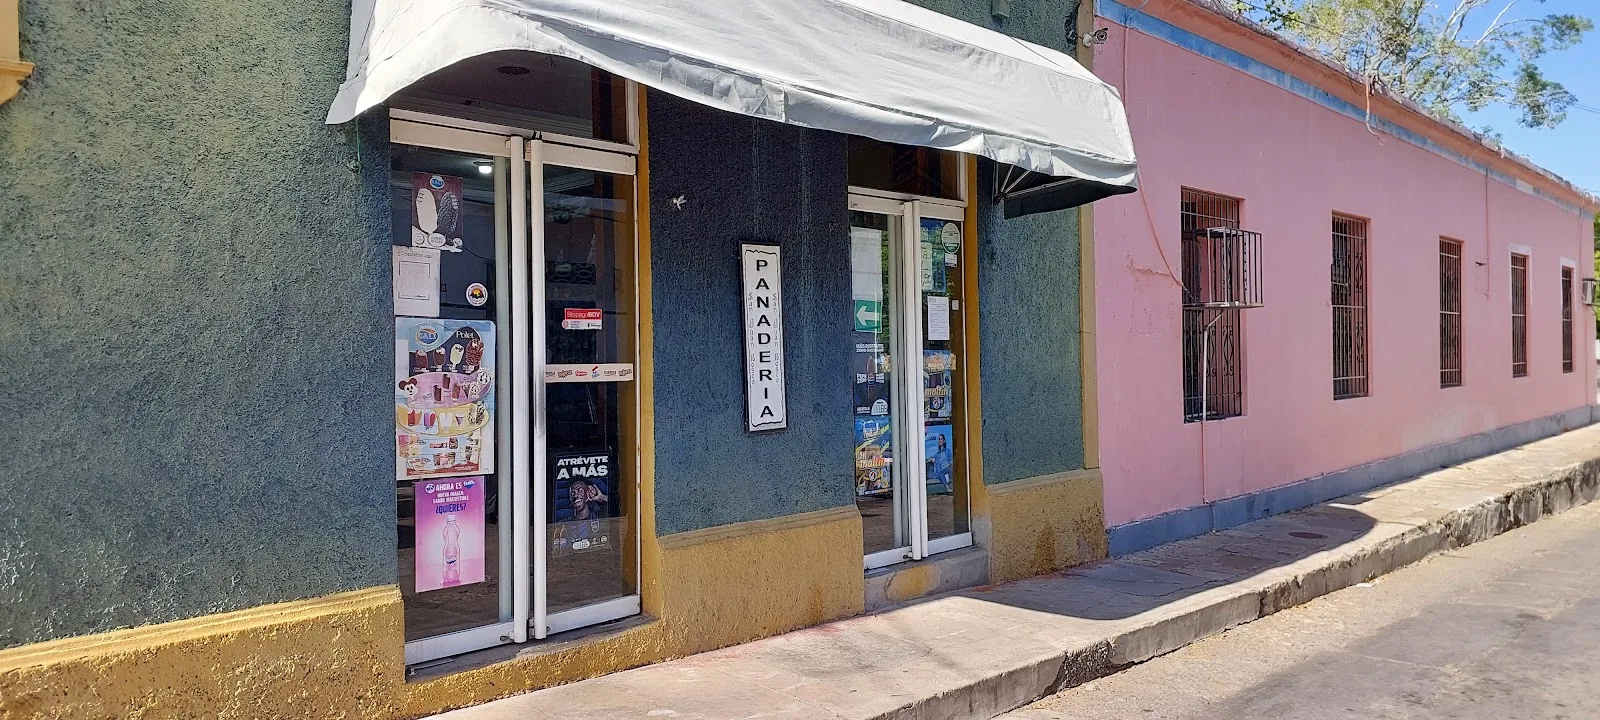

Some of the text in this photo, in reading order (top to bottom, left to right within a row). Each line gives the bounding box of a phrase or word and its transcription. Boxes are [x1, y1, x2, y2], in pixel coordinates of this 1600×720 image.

[456, 330, 475, 339] Polet
[755, 259, 774, 418] PANADERIA
[557, 455, 609, 466] ATRÉVETE
[557, 463, 608, 480] A MÁS
[435, 483, 455, 492] AHORA
[455, 482, 462, 490] ES
[435, 503, 467, 514] ¿QUIERES?
